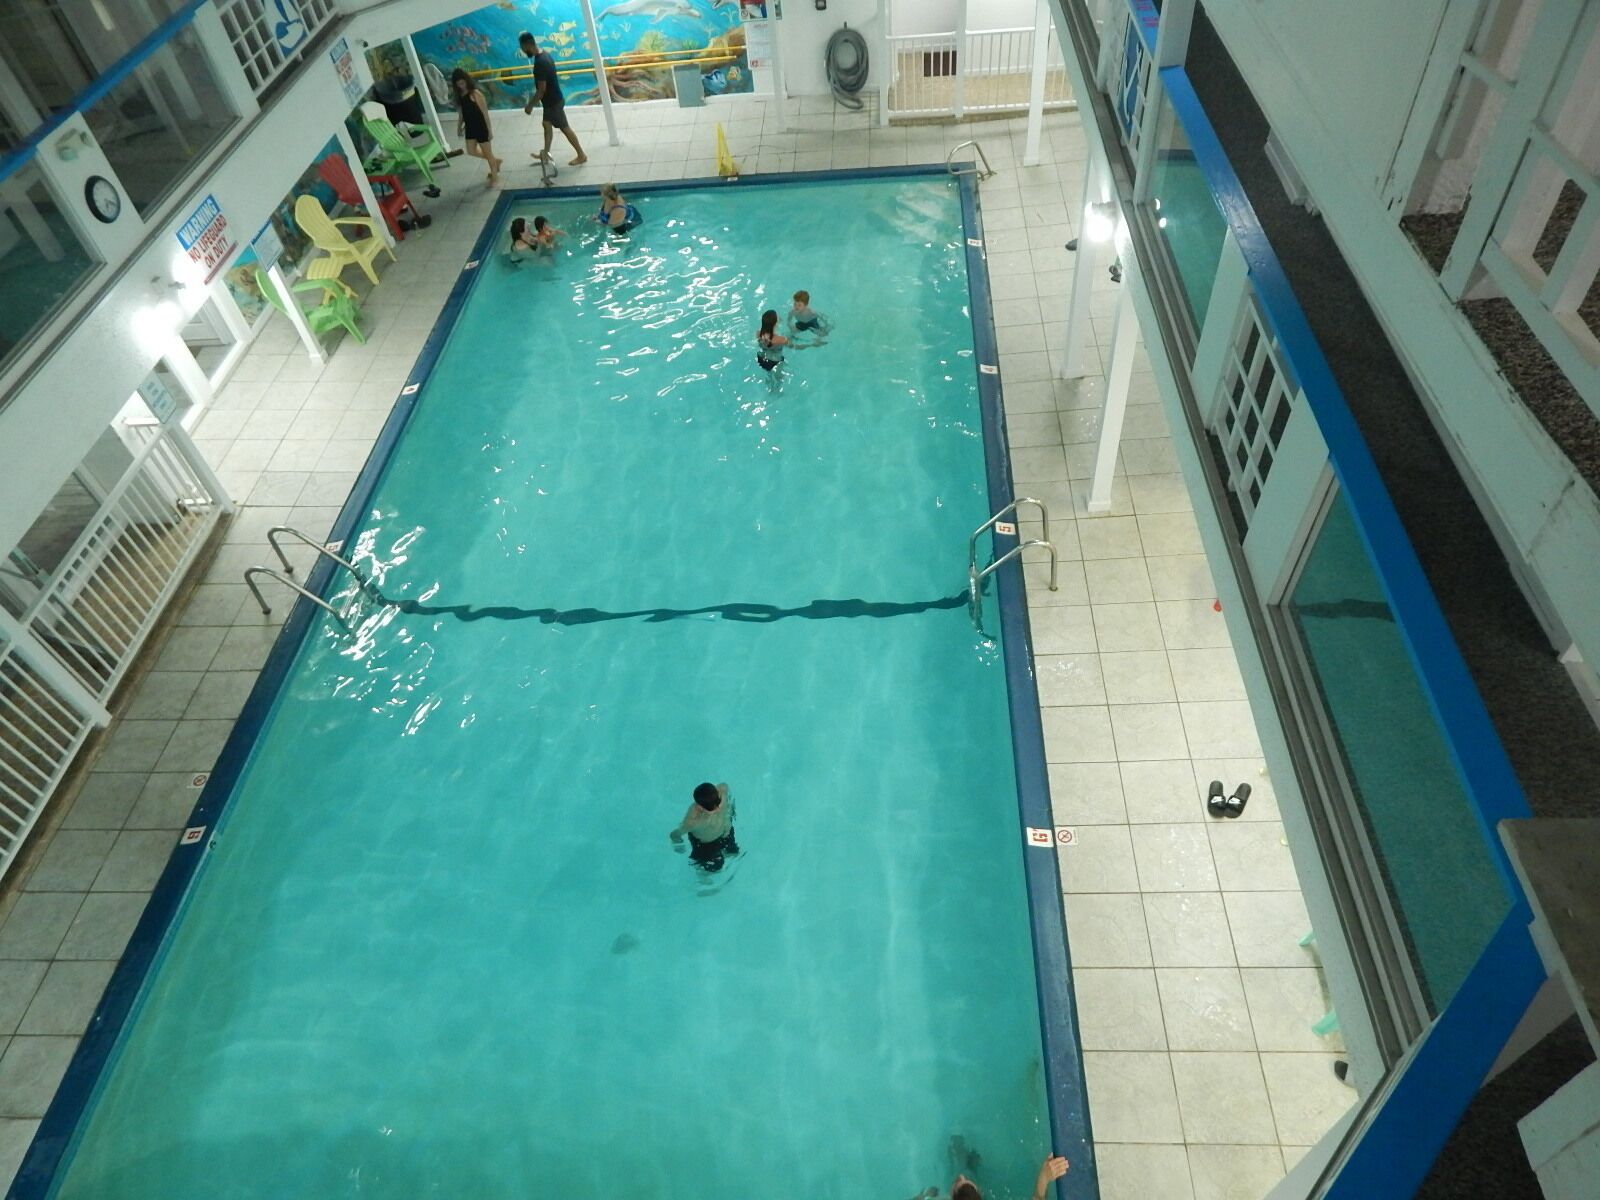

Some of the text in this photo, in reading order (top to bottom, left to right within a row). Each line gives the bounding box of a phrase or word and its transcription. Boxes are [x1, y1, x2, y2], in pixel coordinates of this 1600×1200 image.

[180, 199, 218, 247] WARNING
[188, 214, 227, 263] NO LIFEGUARD
[205, 234, 228, 268] ON DUTY
